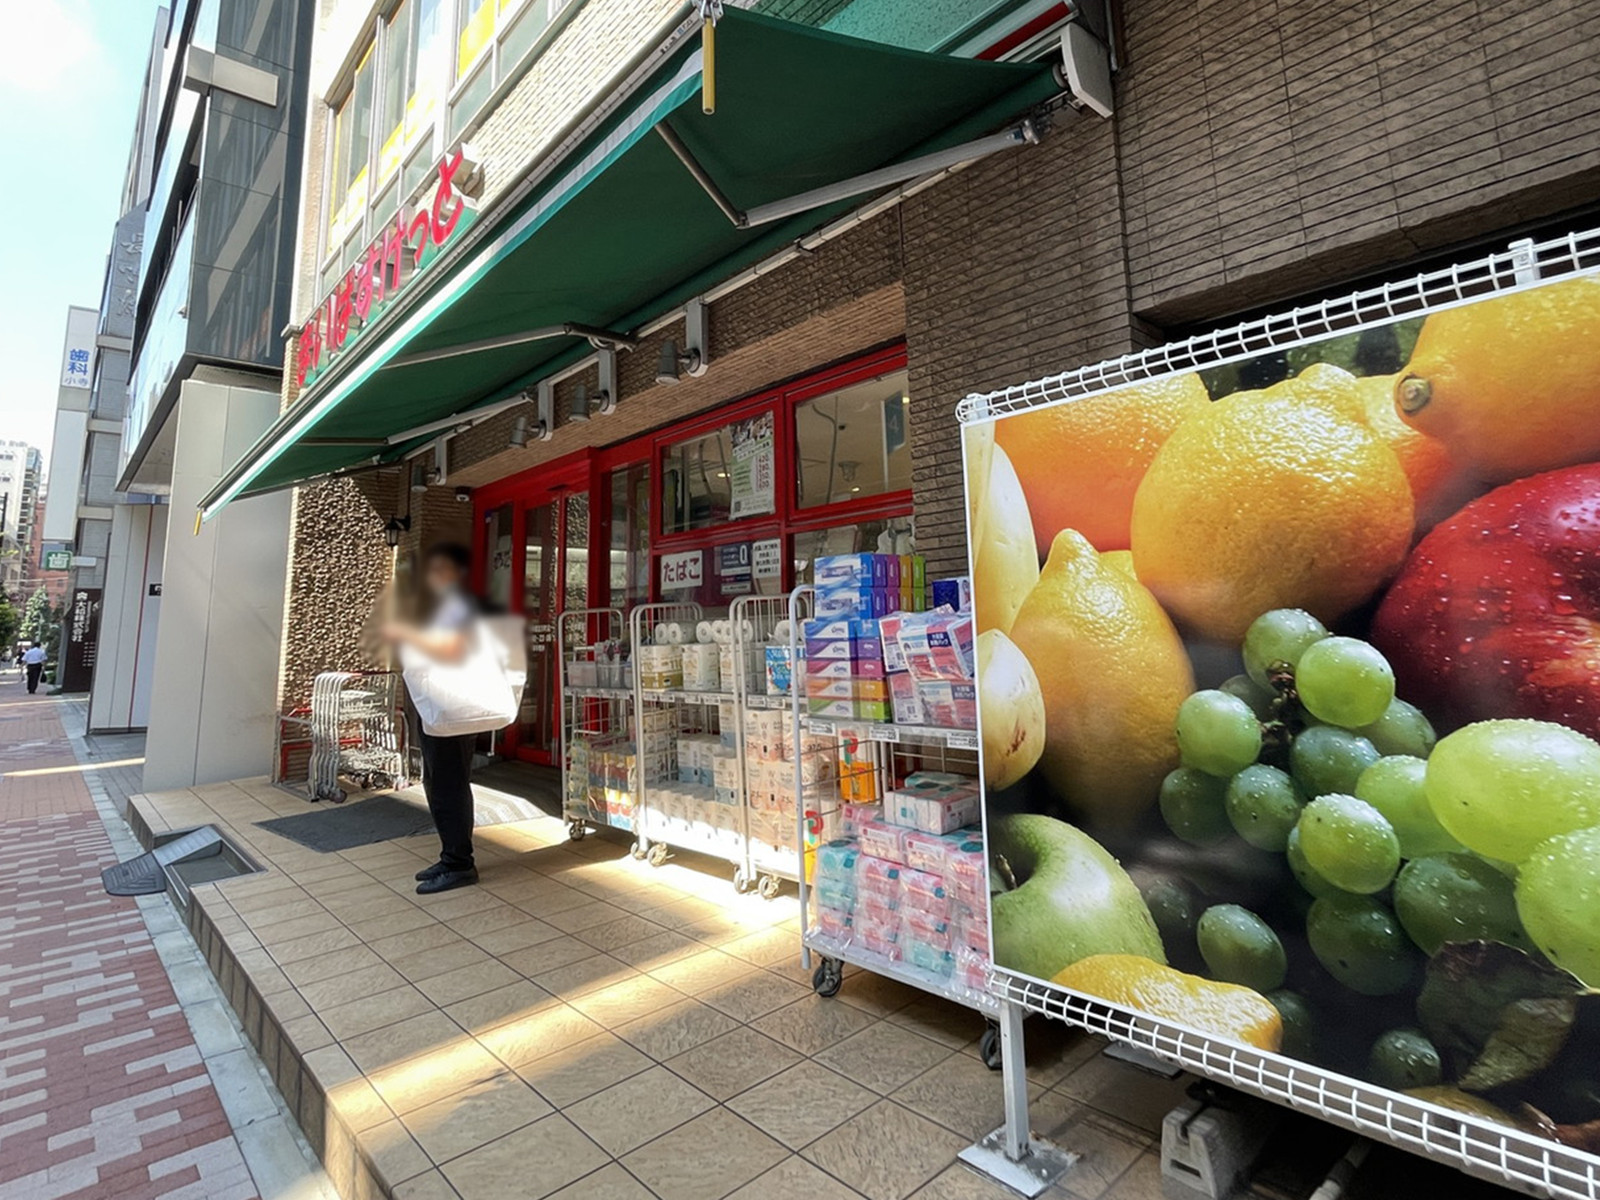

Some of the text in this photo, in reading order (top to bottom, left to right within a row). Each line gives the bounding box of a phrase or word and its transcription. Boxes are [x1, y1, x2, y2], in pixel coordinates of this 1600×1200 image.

[297, 150, 465, 388] まいばすけっと
[67, 348, 90, 376] 歯科
[663, 557, 700, 582] たばこ
